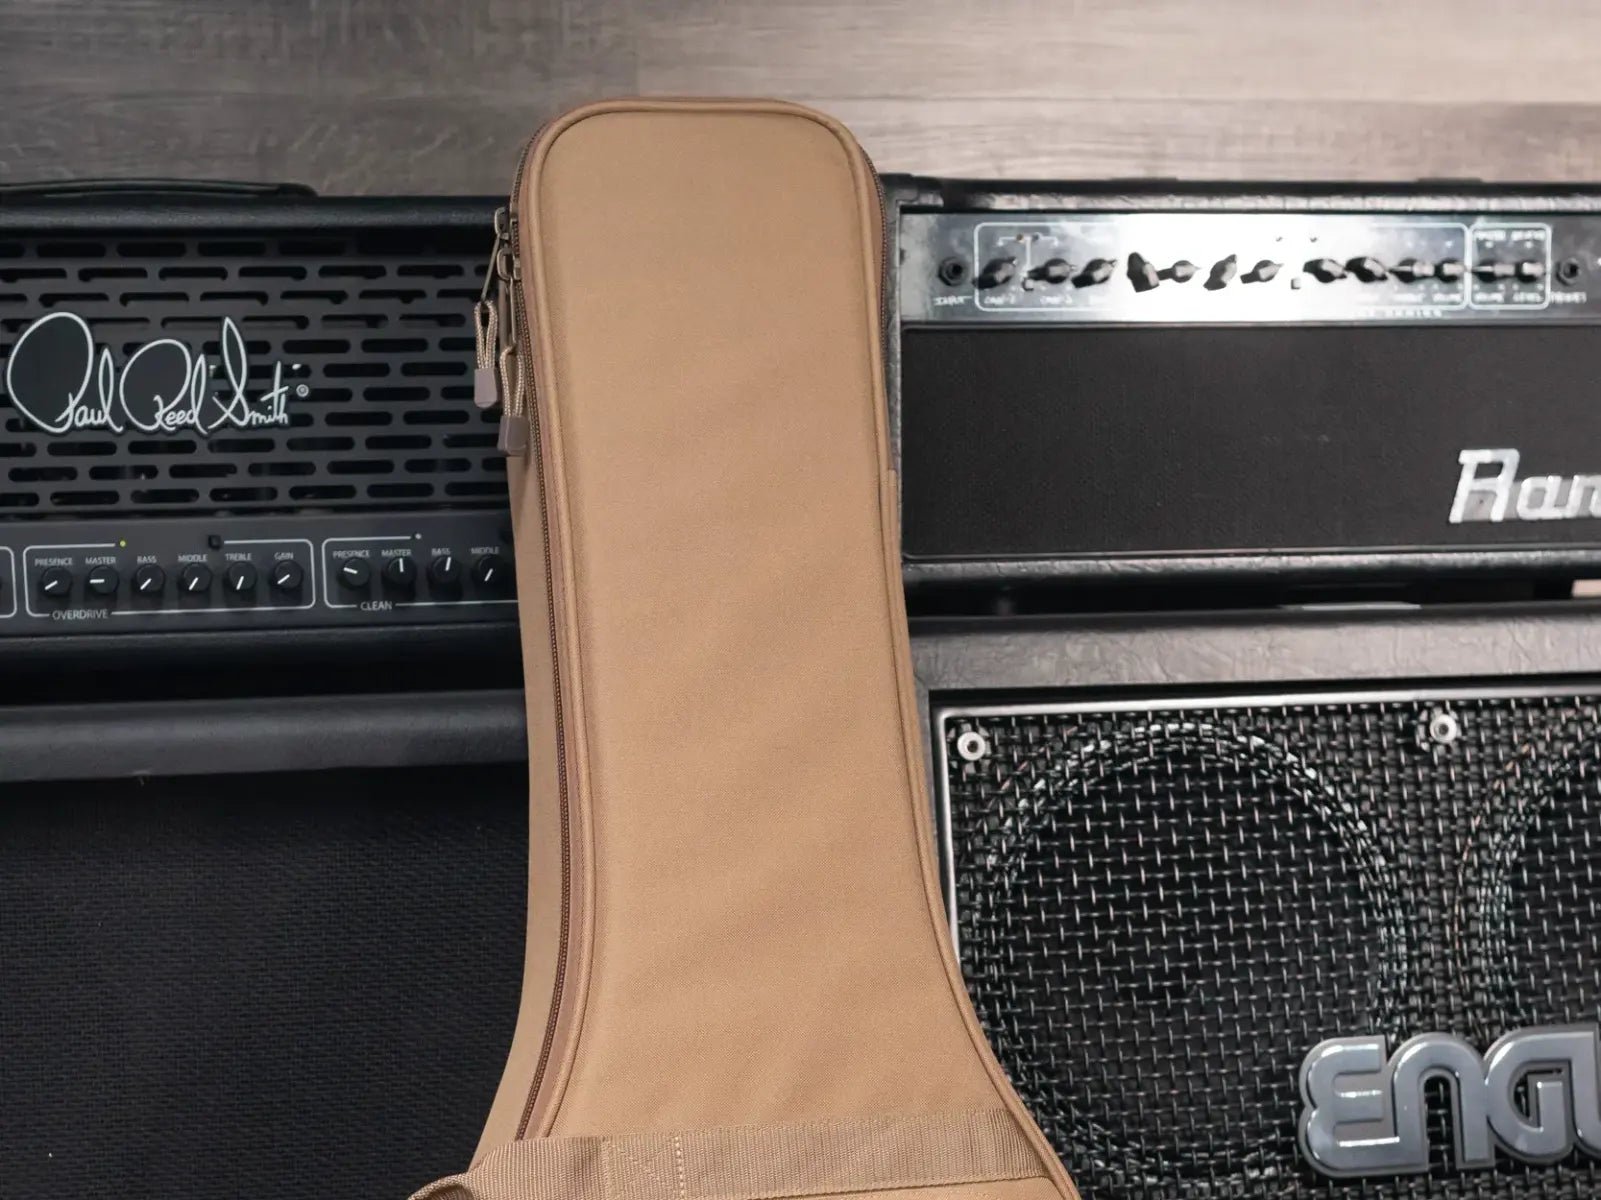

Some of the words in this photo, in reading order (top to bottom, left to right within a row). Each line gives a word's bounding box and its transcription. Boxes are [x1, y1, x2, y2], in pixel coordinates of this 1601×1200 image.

[7, 312, 123, 433] Paul
[119, 339, 207, 434] Reed
[208, 316, 289, 430] Smith
[34, 557, 73, 567] PRESENCE
[85, 556, 117, 566] MASTER
[137, 555, 158, 564] BASS
[178, 553, 208, 563] MIDDLE
[225, 552, 253, 561] TREBLE
[274, 551, 294, 560] GAIN
[333, 549, 370, 559] PRESENCE
[381, 548, 412, 557] MASTER
[431, 547, 452, 556] BASS
[360, 600, 393, 611] CLEAN
[51, 608, 109, 620] OVERDRIVE
